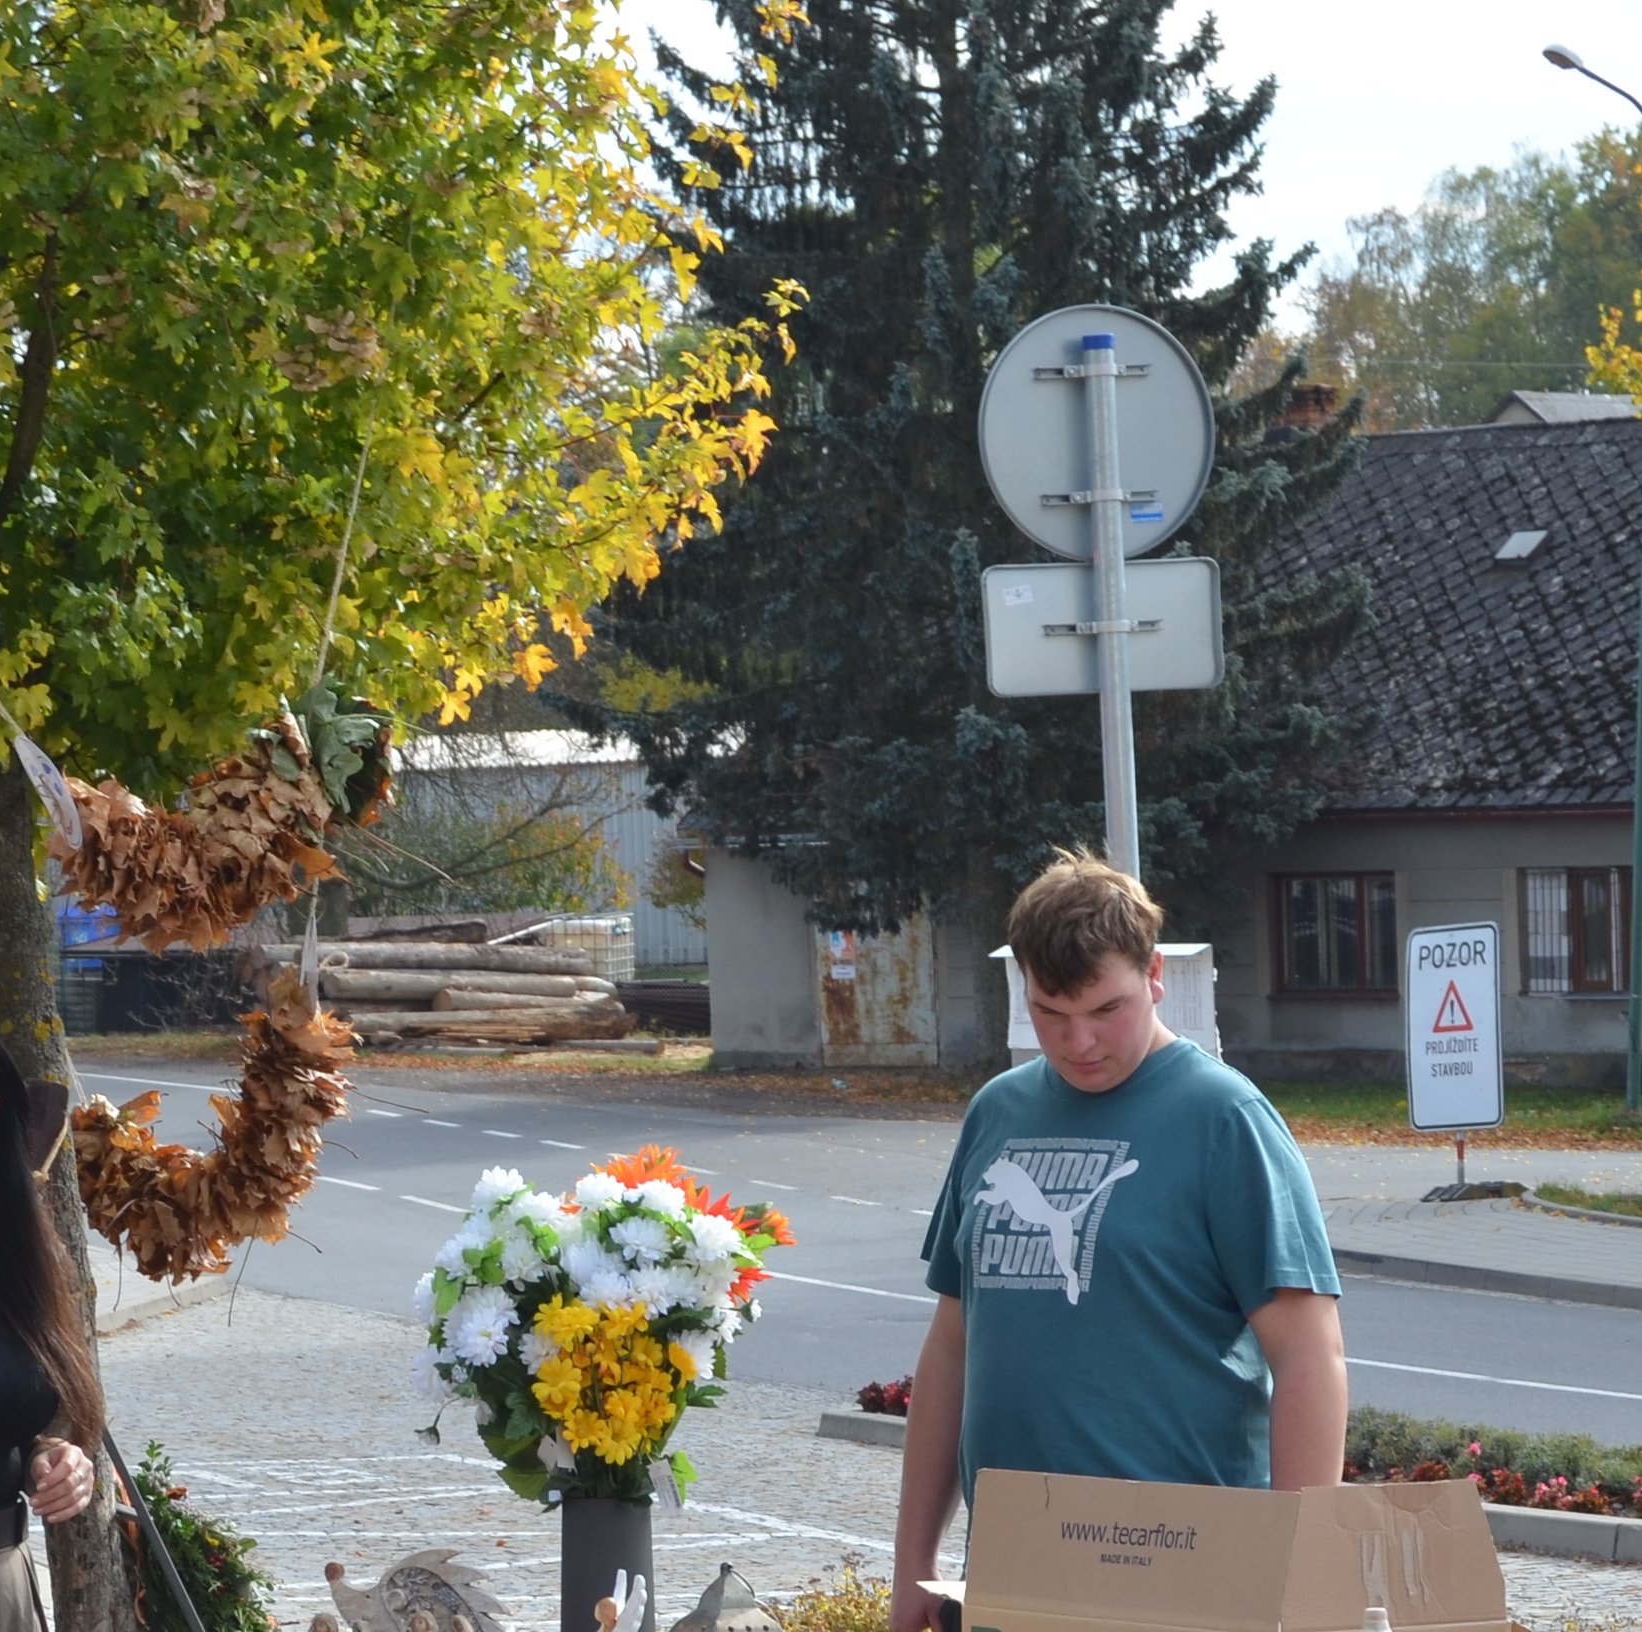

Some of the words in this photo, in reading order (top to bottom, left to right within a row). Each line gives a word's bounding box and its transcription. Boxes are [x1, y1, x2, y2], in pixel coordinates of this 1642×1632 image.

[1418, 941, 1487, 971] POZOR
[1425, 1036, 1479, 1056] PROJÍŽDÍTE
[1431, 1061, 1474, 1077] STAVBOU
[1061, 1521, 1197, 1550] www.tecarflor.it
[1100, 1553, 1121, 1564] MADE
[1123, 1555, 1131, 1564] IN
[1132, 1556, 1153, 1567] ITALY
